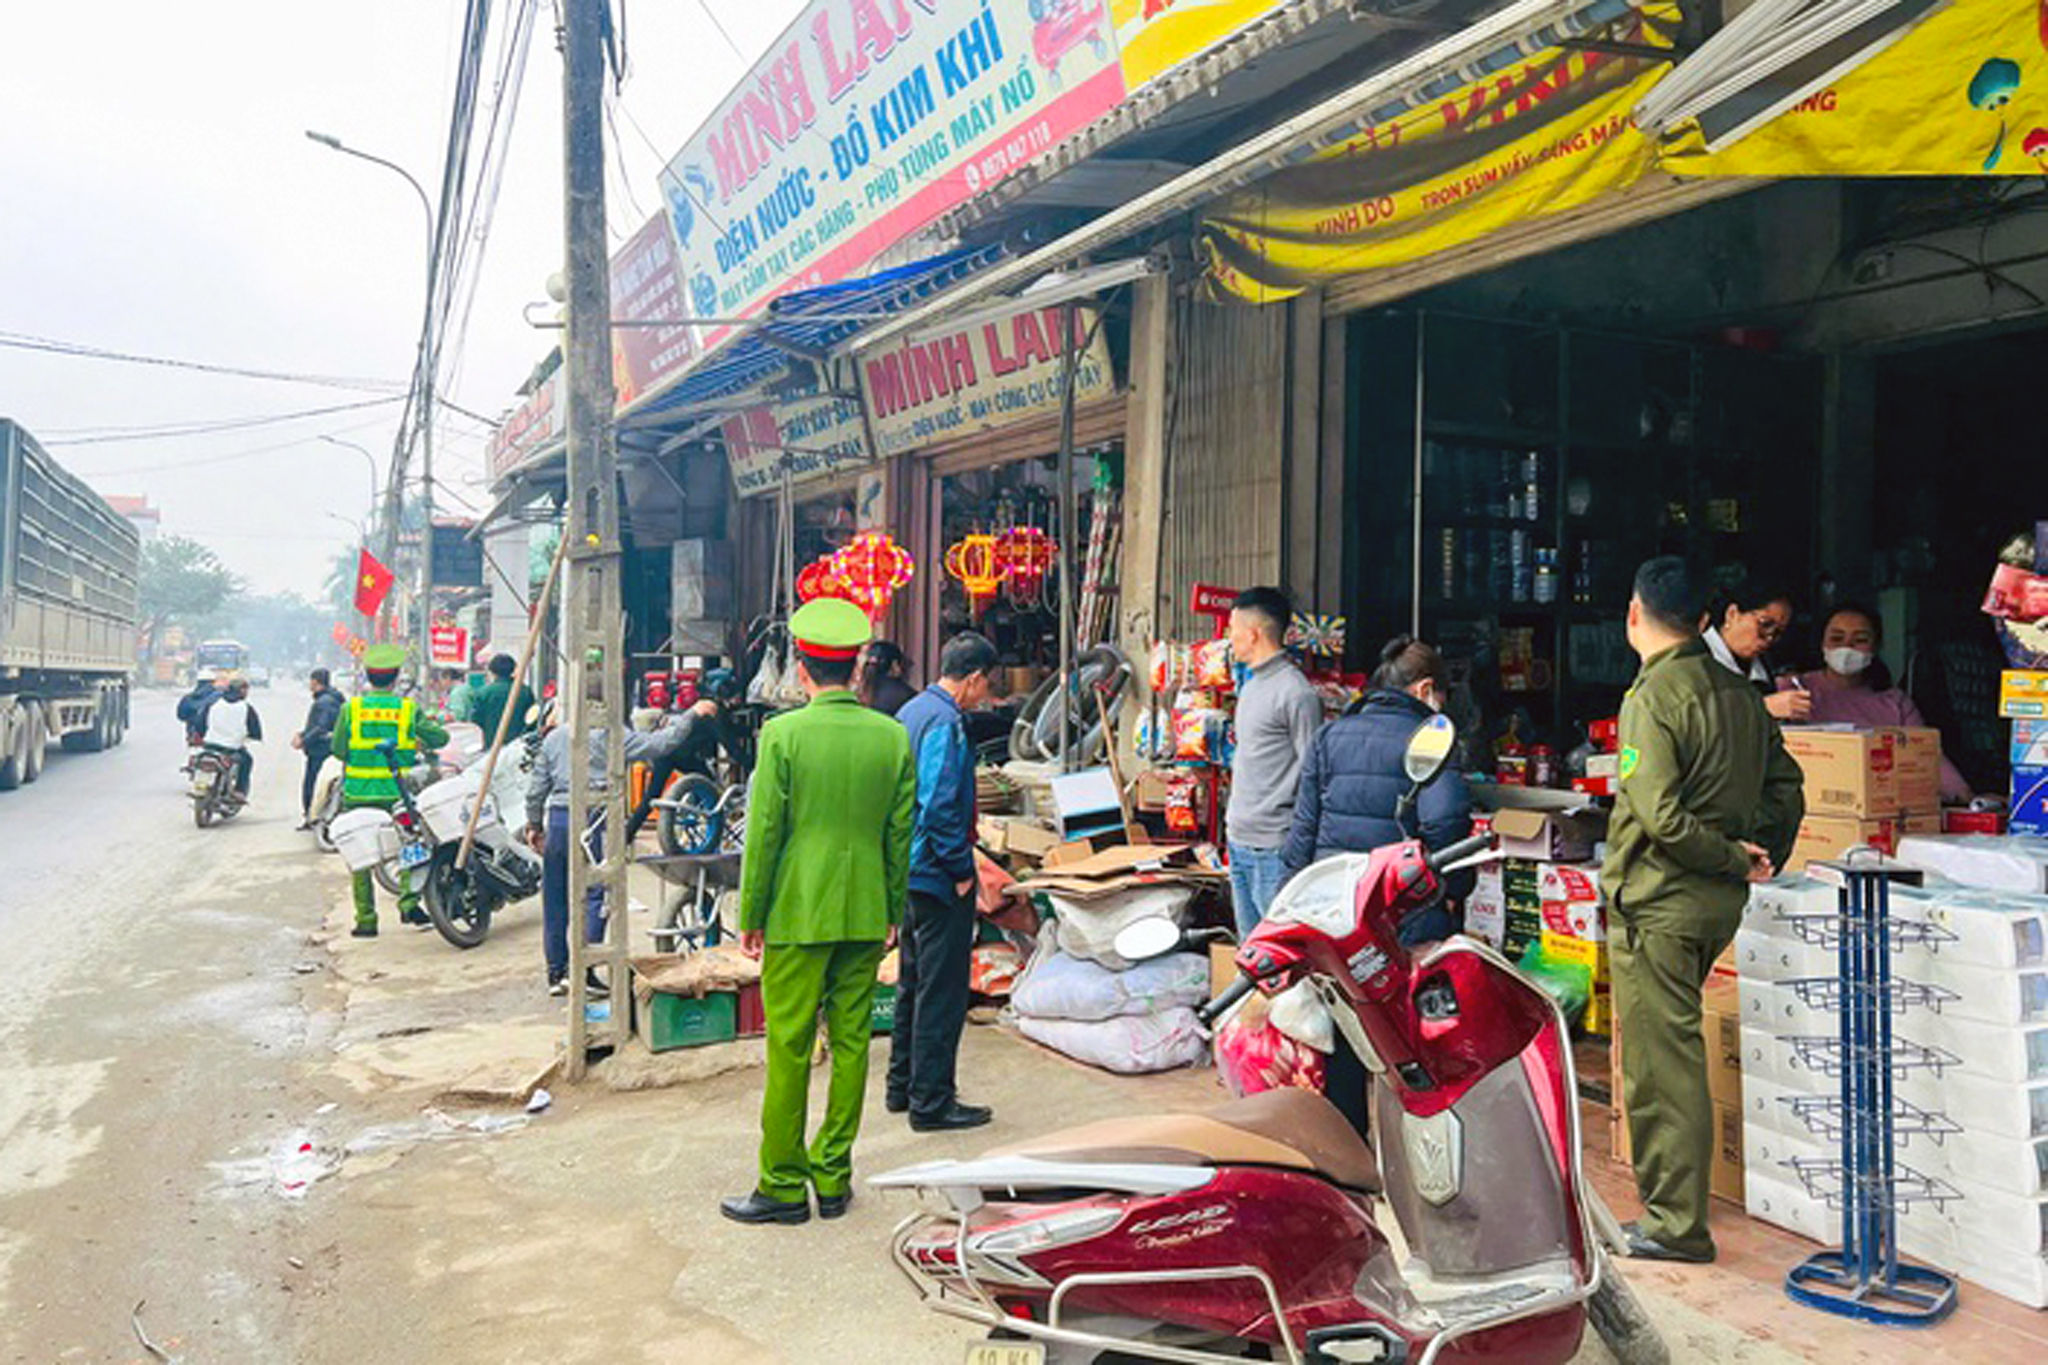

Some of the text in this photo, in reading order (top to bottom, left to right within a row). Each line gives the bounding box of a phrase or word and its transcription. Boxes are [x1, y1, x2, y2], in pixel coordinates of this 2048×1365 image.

[706, 40, 816, 205] MINH
[870, 65, 936, 150] KIM
[935, 0, 1004, 98] KHÍ
[949, 94, 997, 149] MÁY
